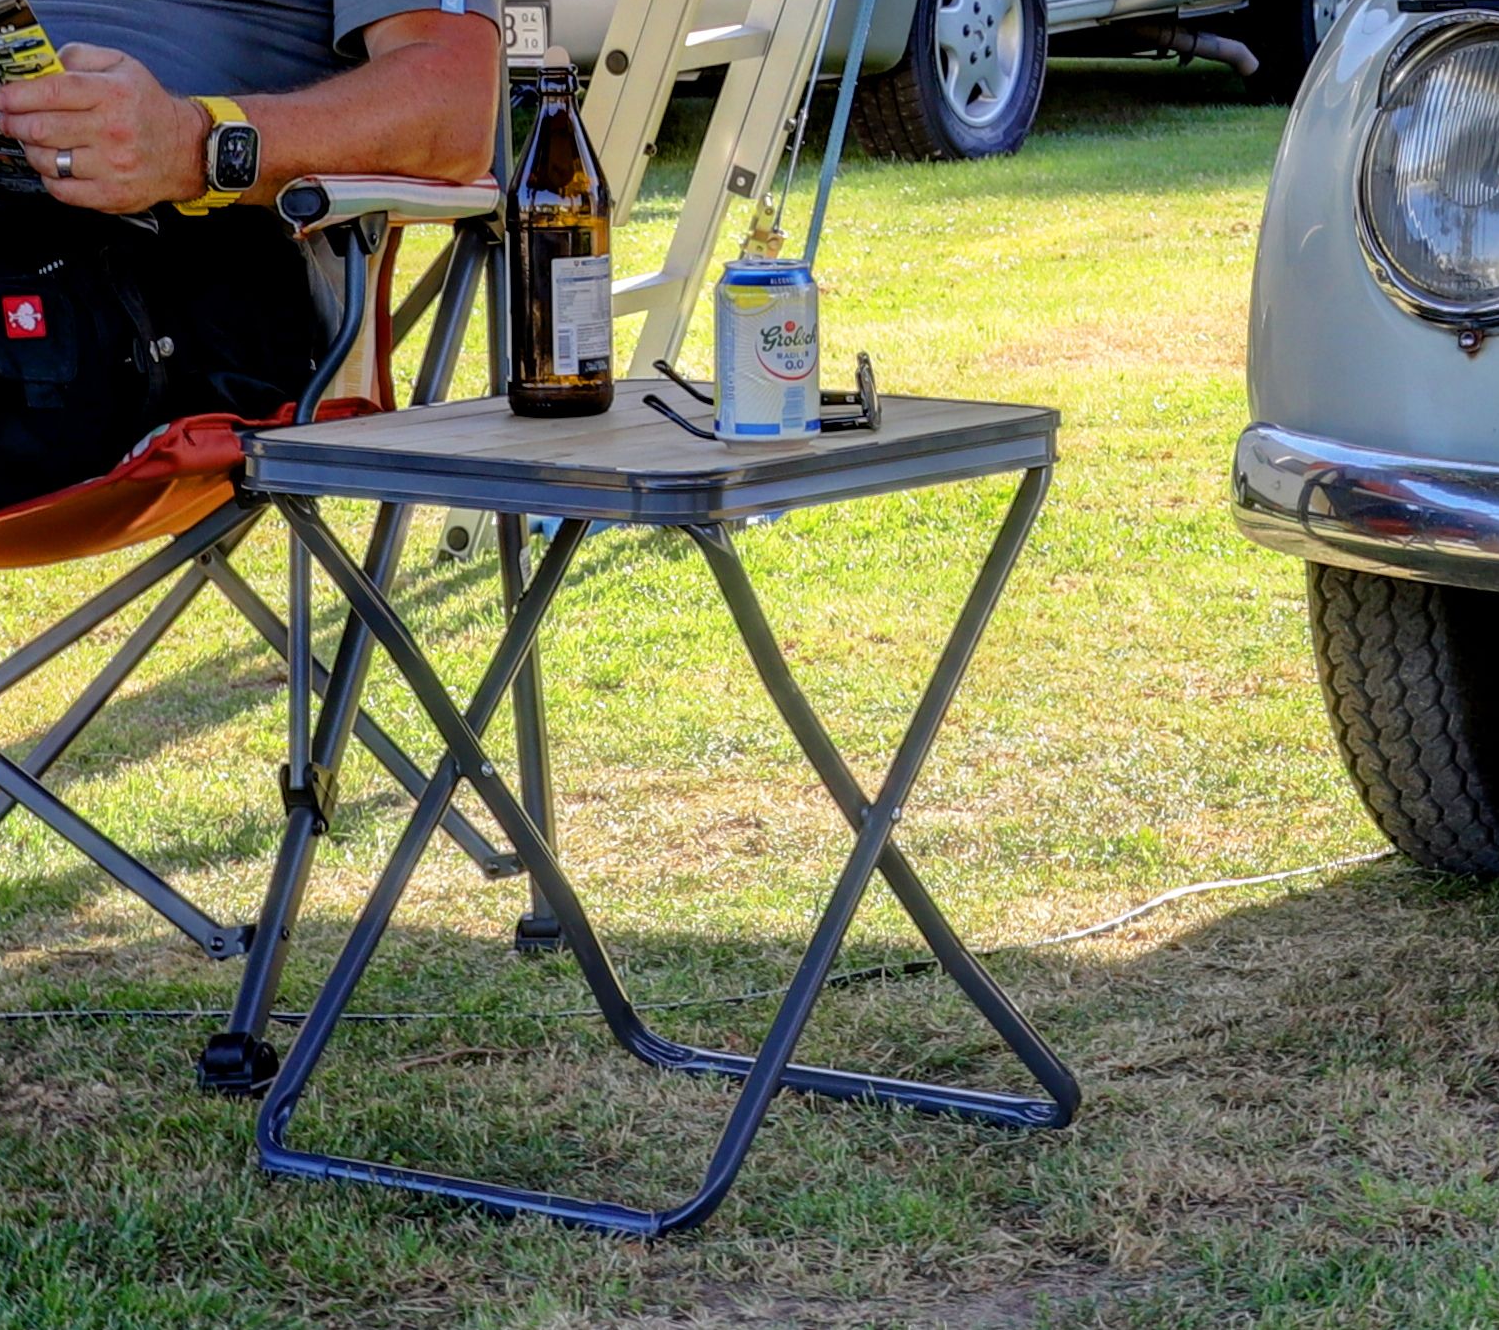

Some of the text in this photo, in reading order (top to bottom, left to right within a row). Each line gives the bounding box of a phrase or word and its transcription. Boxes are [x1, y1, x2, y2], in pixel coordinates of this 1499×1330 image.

[521, 12, 537, 23] 04
[524, 37, 539, 49] 10
[777, 351, 810, 360] RADLR
